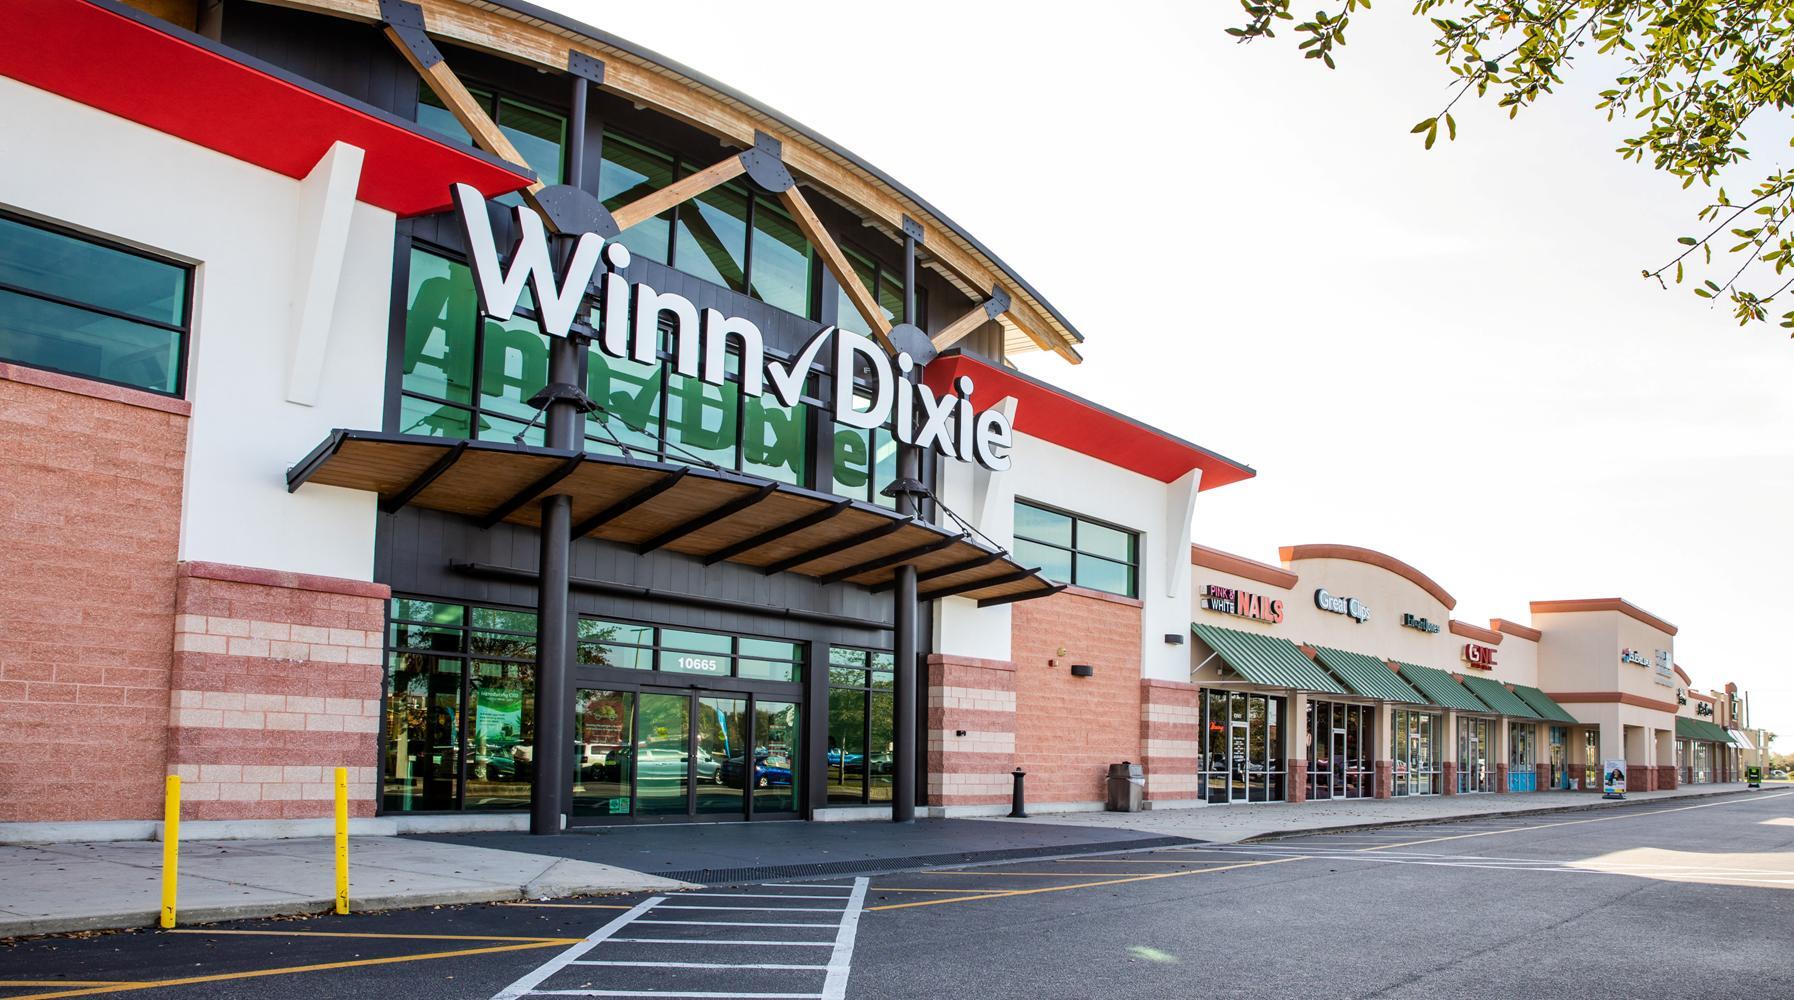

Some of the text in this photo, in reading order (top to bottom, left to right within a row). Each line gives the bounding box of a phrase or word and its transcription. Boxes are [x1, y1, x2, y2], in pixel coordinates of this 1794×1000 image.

[451, 183, 1013, 472] Winn Dixie
[1210, 585, 1235, 600] PINK &
[1210, 598, 1235, 614] WHITE
[1237, 590, 1284, 624] NAILS
[1316, 588, 1371, 624] Great Clips
[678, 657, 717, 671] 10665
[1467, 643, 1498, 665] GNC
